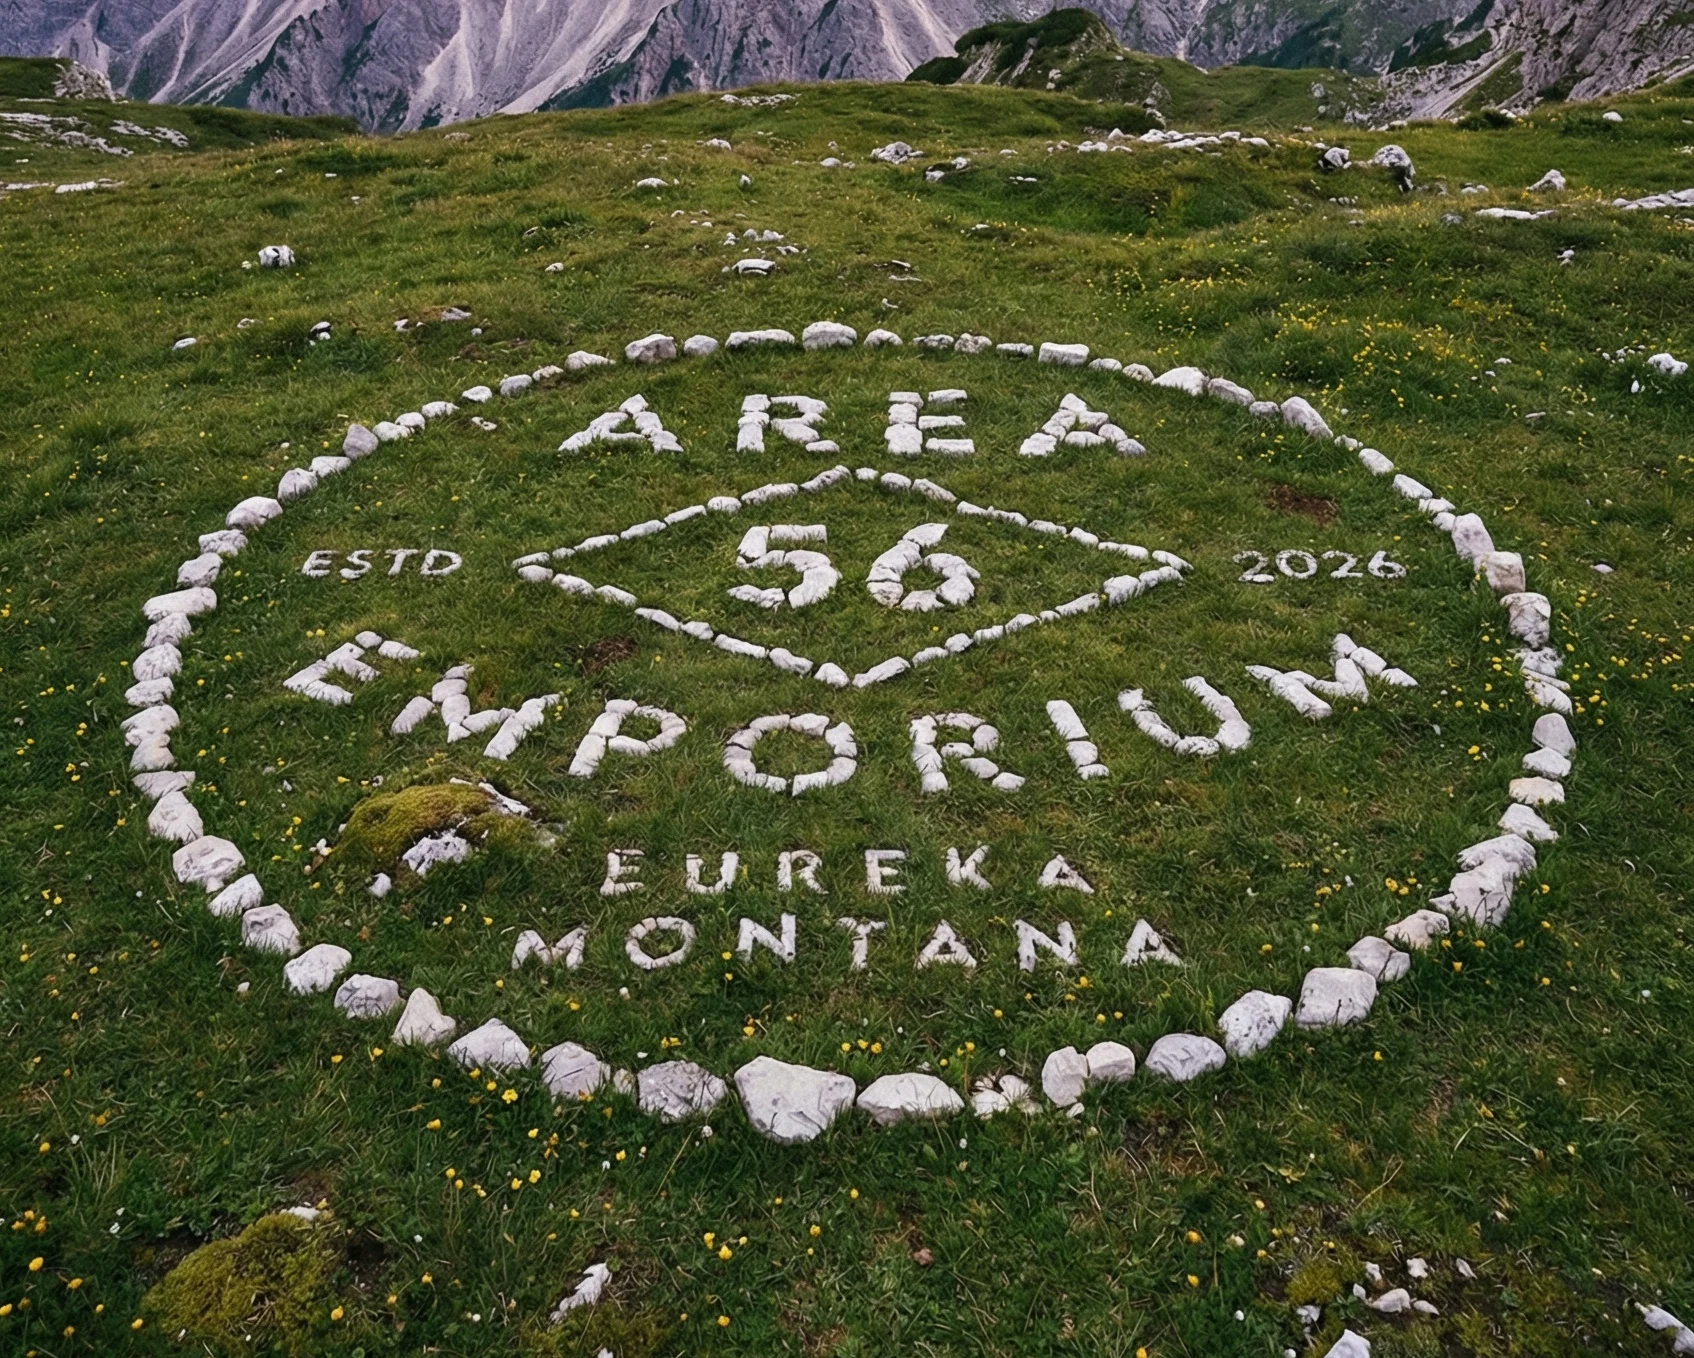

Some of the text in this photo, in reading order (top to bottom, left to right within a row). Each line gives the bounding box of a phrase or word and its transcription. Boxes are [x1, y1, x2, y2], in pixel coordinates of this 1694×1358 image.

[558, 390, 1145, 455] AREA
[302, 548, 462, 579] ESTD
[727, 523, 980, 612] 56
[1233, 549, 1407, 583] 2026
[283, 632, 1418, 797] EMPORIUM
[600, 845, 1094, 895] EUREKA
[513, 913, 1187, 971] MONTANA
